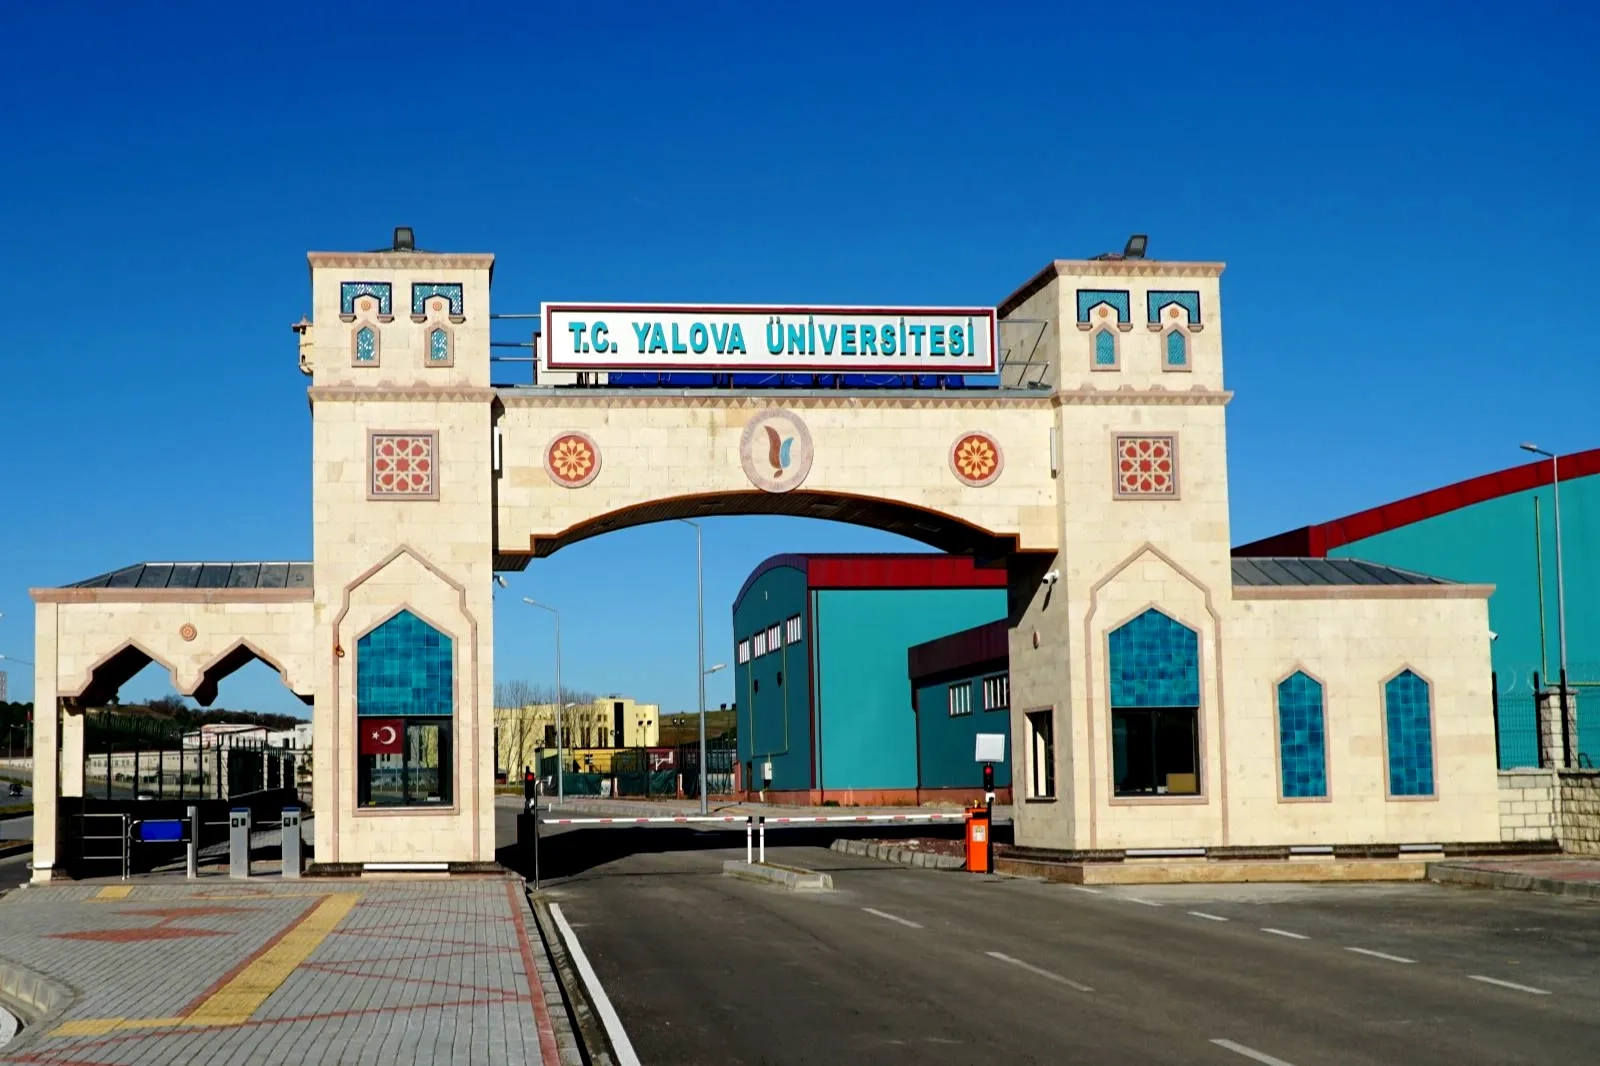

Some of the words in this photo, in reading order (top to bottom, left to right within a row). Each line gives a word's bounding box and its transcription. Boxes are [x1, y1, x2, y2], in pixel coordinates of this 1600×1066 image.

[568, 320, 618, 354] T.C.
[631, 321, 747, 355] YALOVA
[766, 315, 975, 357] ÜNİVERSİTESİ
